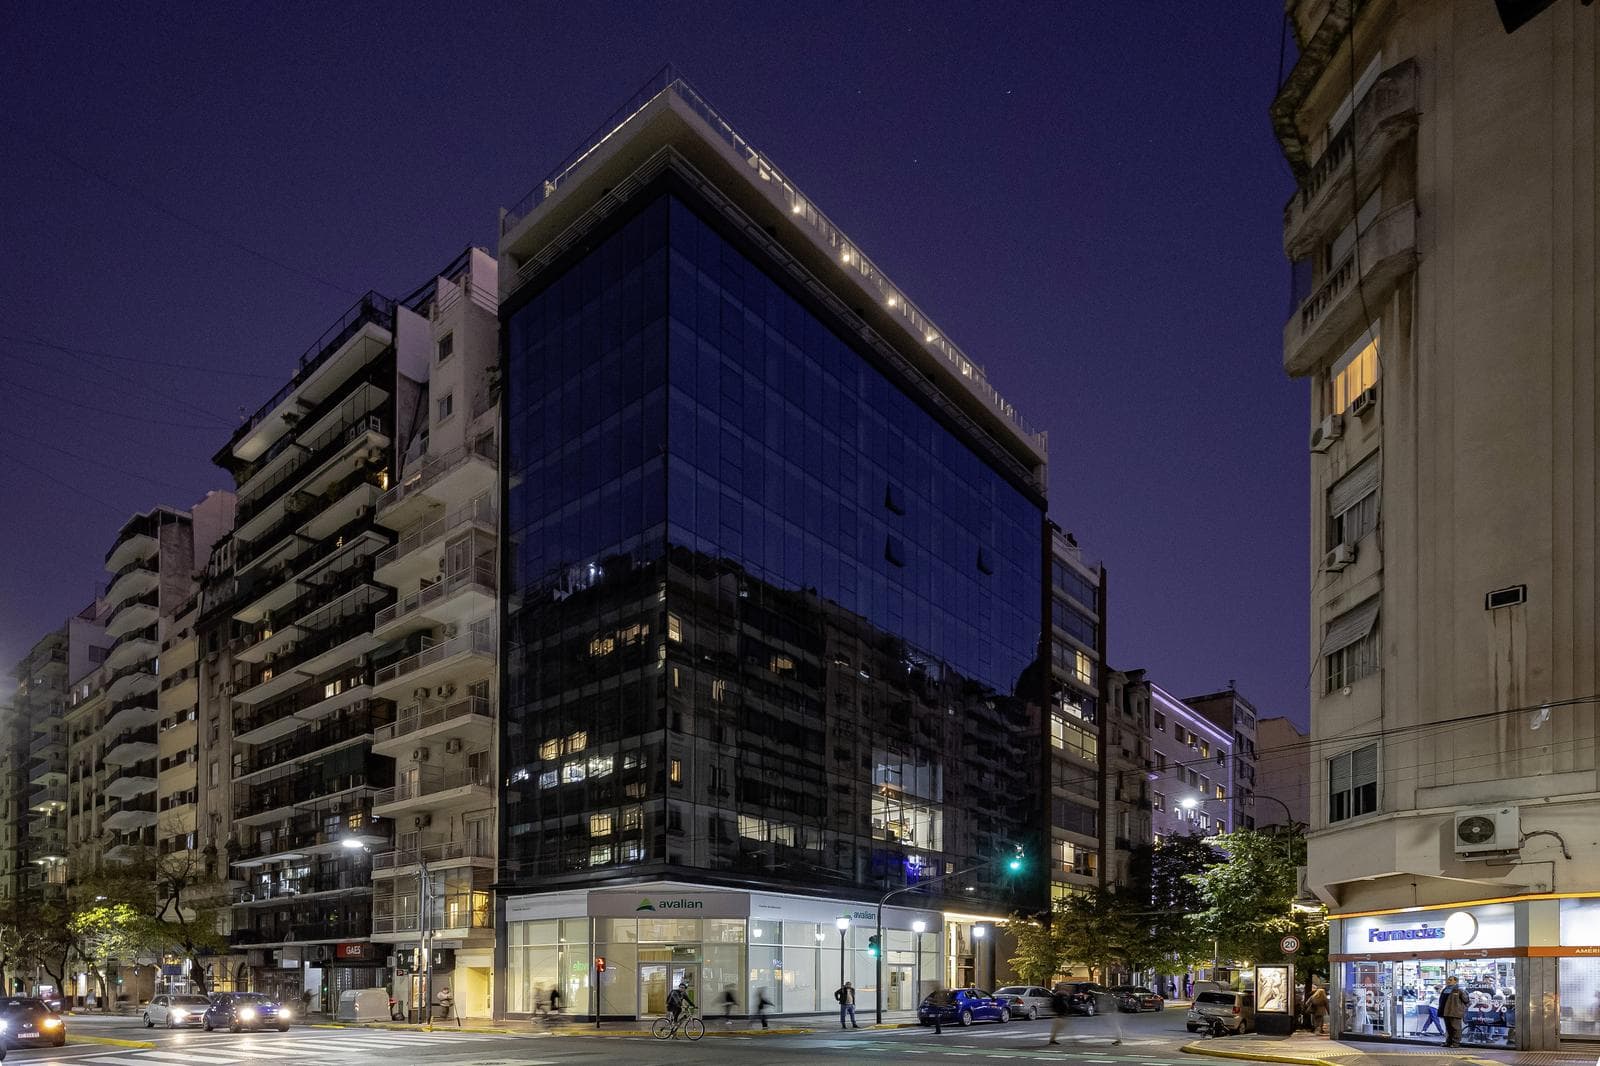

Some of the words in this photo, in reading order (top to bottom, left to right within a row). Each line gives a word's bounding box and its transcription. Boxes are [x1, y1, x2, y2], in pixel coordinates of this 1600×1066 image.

[659, 899, 703, 909] avalian
[853, 911, 876, 920] avalian
[1368, 923, 1445, 942] Farmacias
[1284, 940, 1296, 949] 20
[346, 946, 361, 955] GAES
[1468, 991, 1507, 1013] 23%
